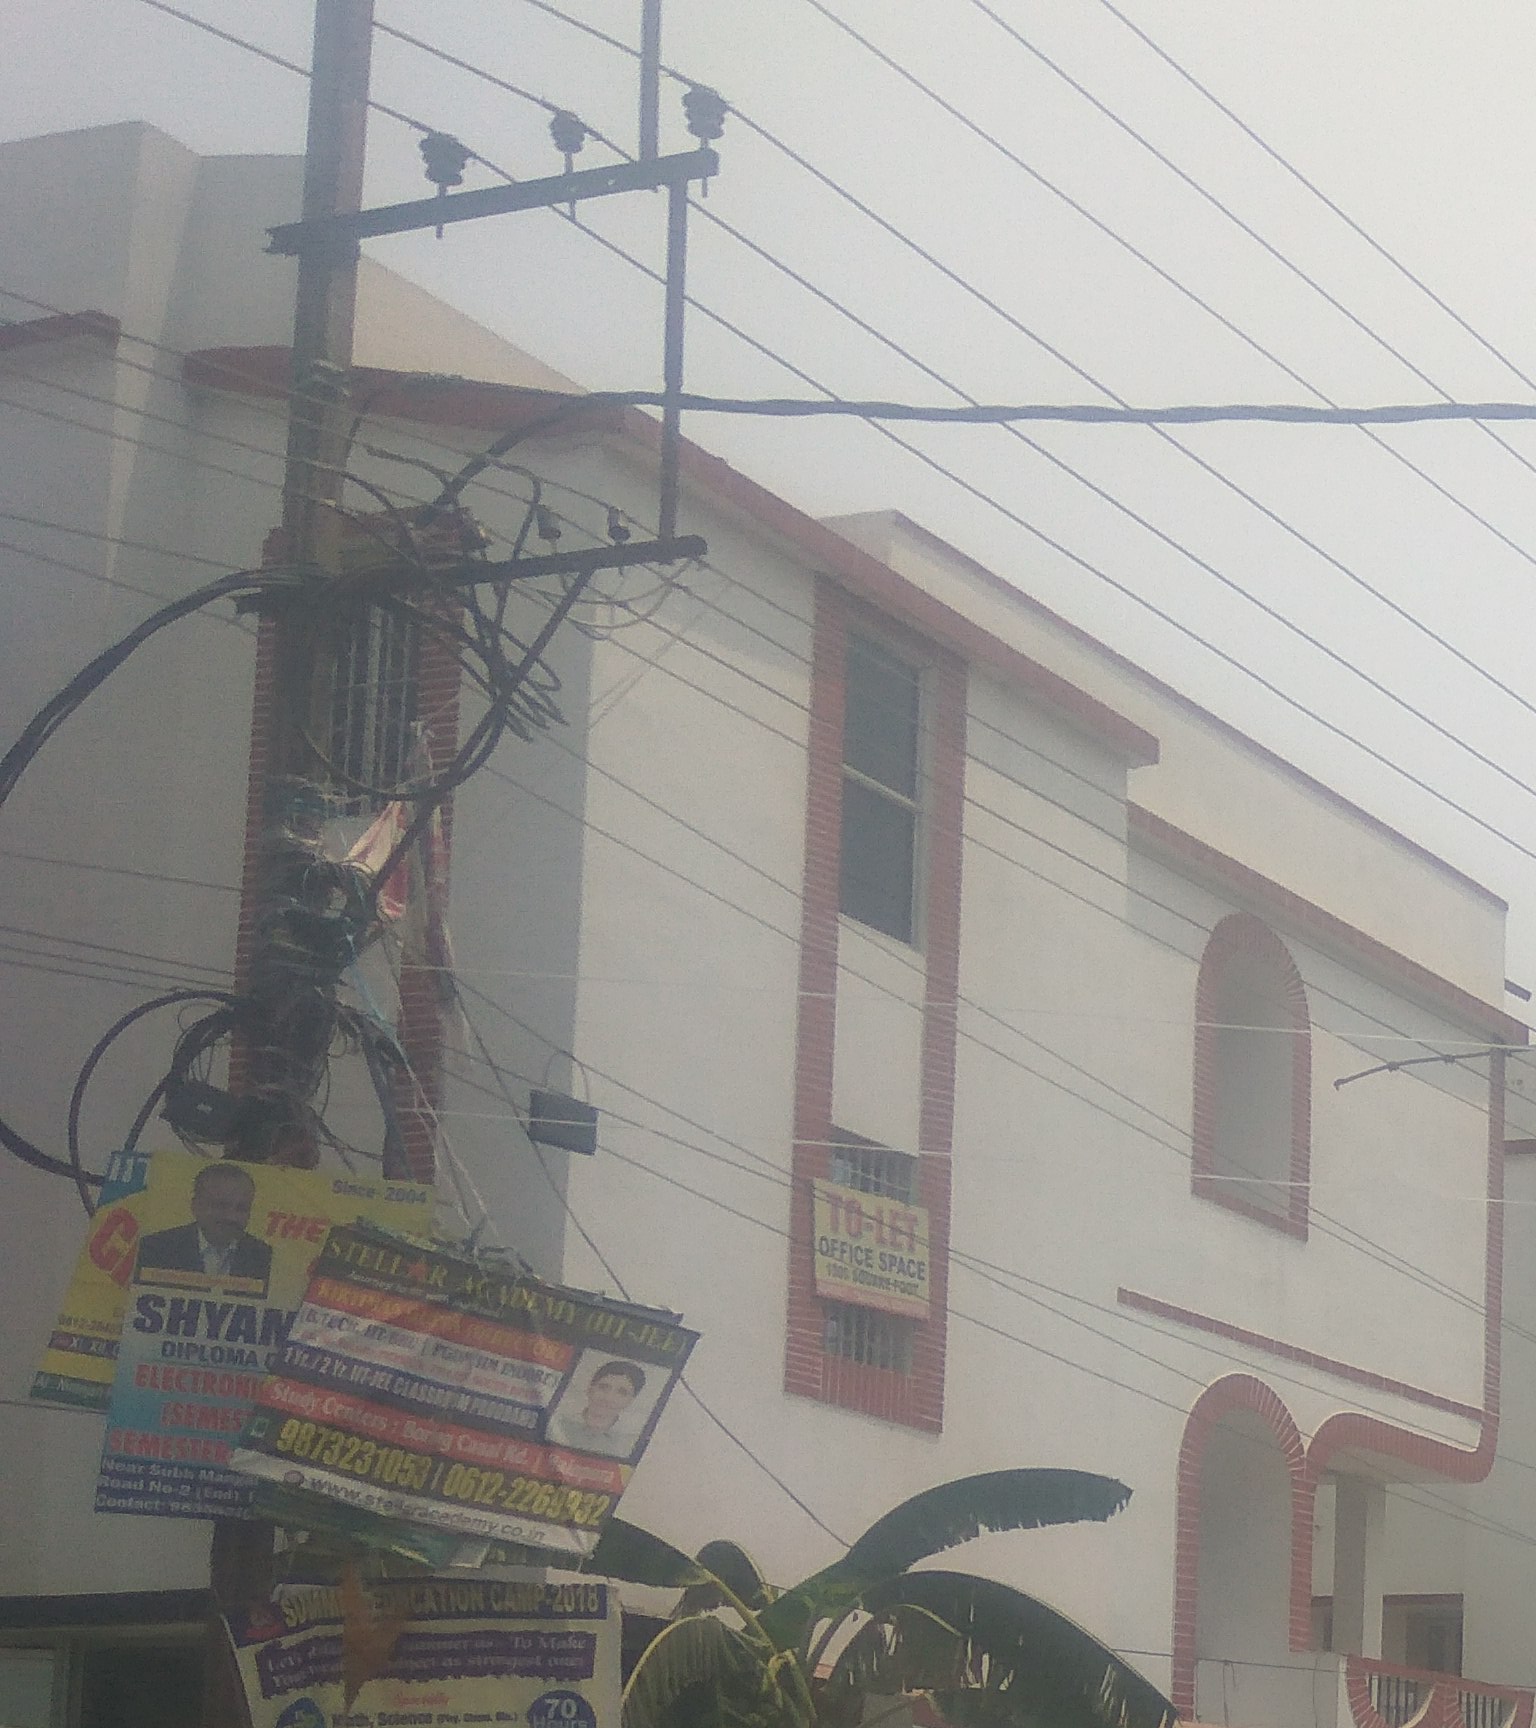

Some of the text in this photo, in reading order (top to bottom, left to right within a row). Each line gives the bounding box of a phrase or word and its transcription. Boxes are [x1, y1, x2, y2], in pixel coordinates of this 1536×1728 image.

[265, 1210, 332, 1243] THE
[330, 1238, 450, 1289] STELLR
[818, 1235, 874, 1269] OFFICE
[878, 1251, 926, 1281] SPACE
[160, 1339, 260, 1367] DIPLOMA
[101, 1458, 144, 1475] Near
[100, 1474, 145, 1490] Road
[281, 1584, 345, 1628] SUMM
[377, 1711, 433, 1727] Science
[544, 1698, 579, 1720] 70
